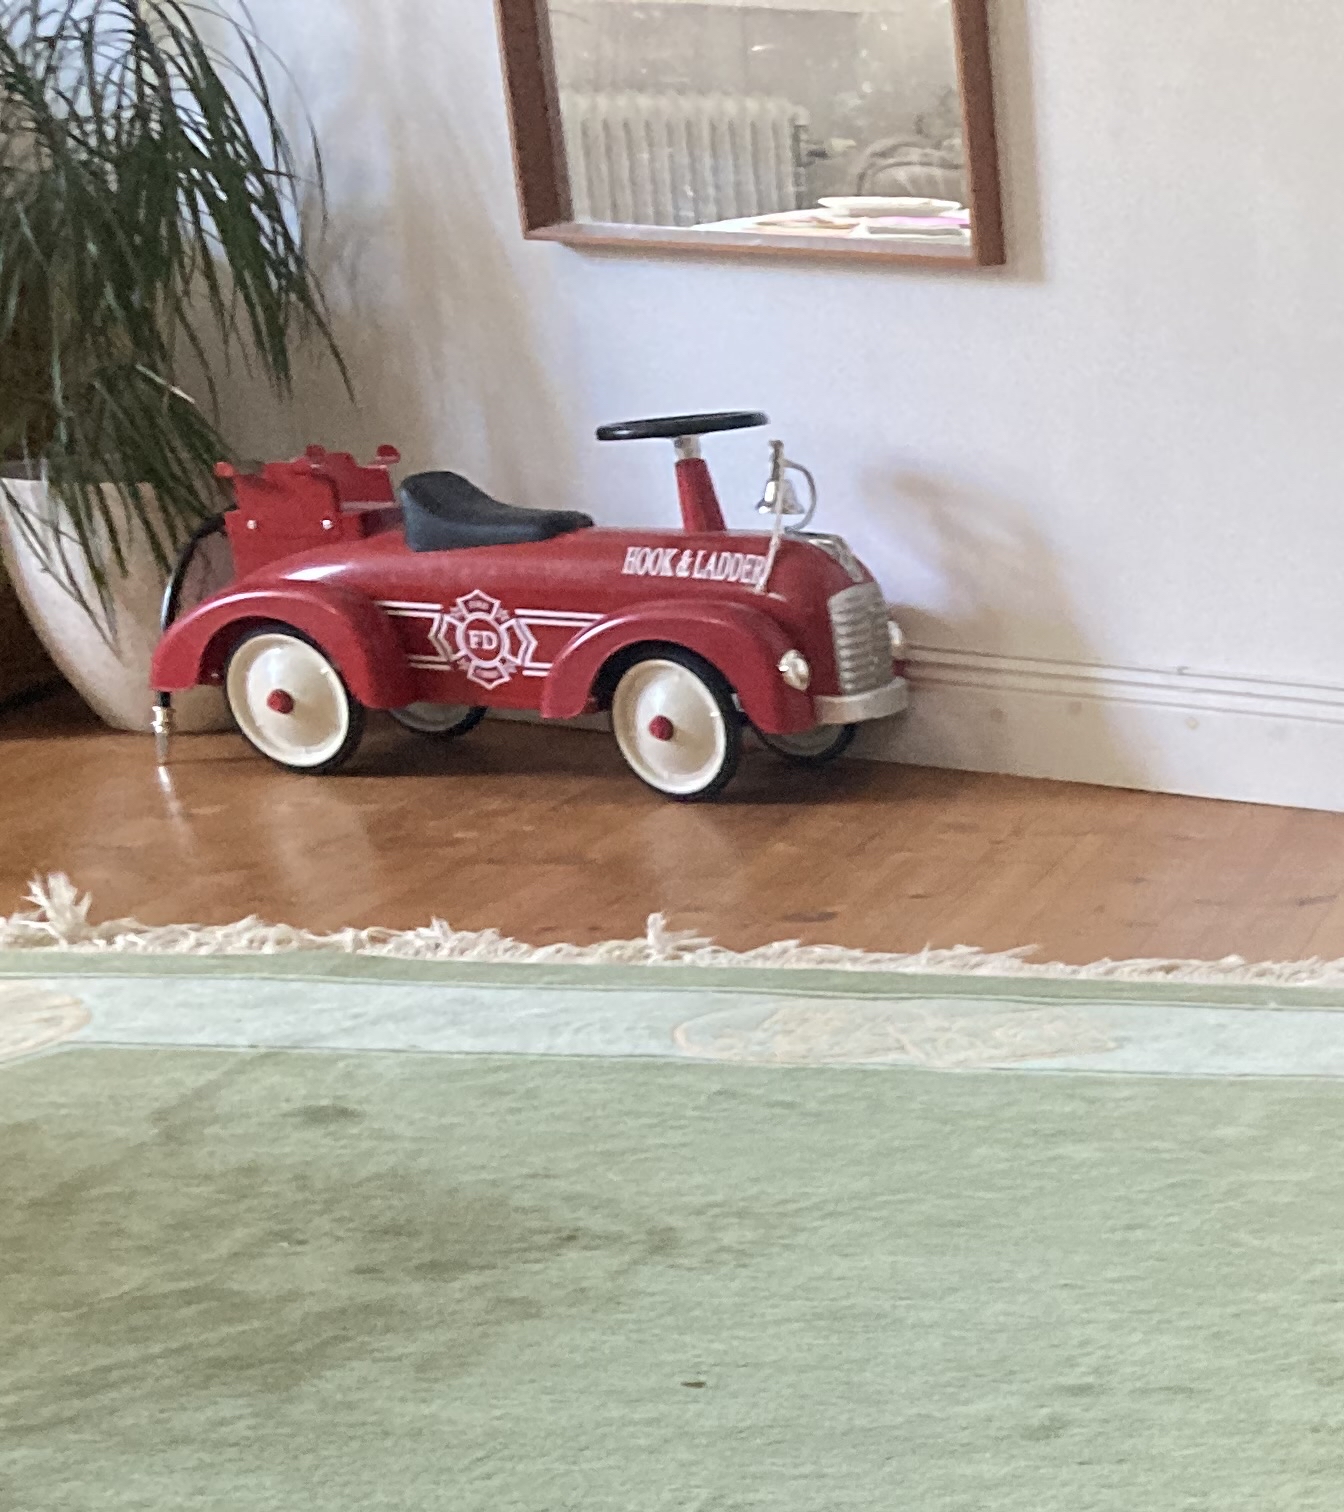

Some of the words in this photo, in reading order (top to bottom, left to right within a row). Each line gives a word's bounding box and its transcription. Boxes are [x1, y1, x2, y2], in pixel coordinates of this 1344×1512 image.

[621, 546, 678, 577] HOOK
[675, 549, 692, 578] &
[468, 629, 498, 650] FD
